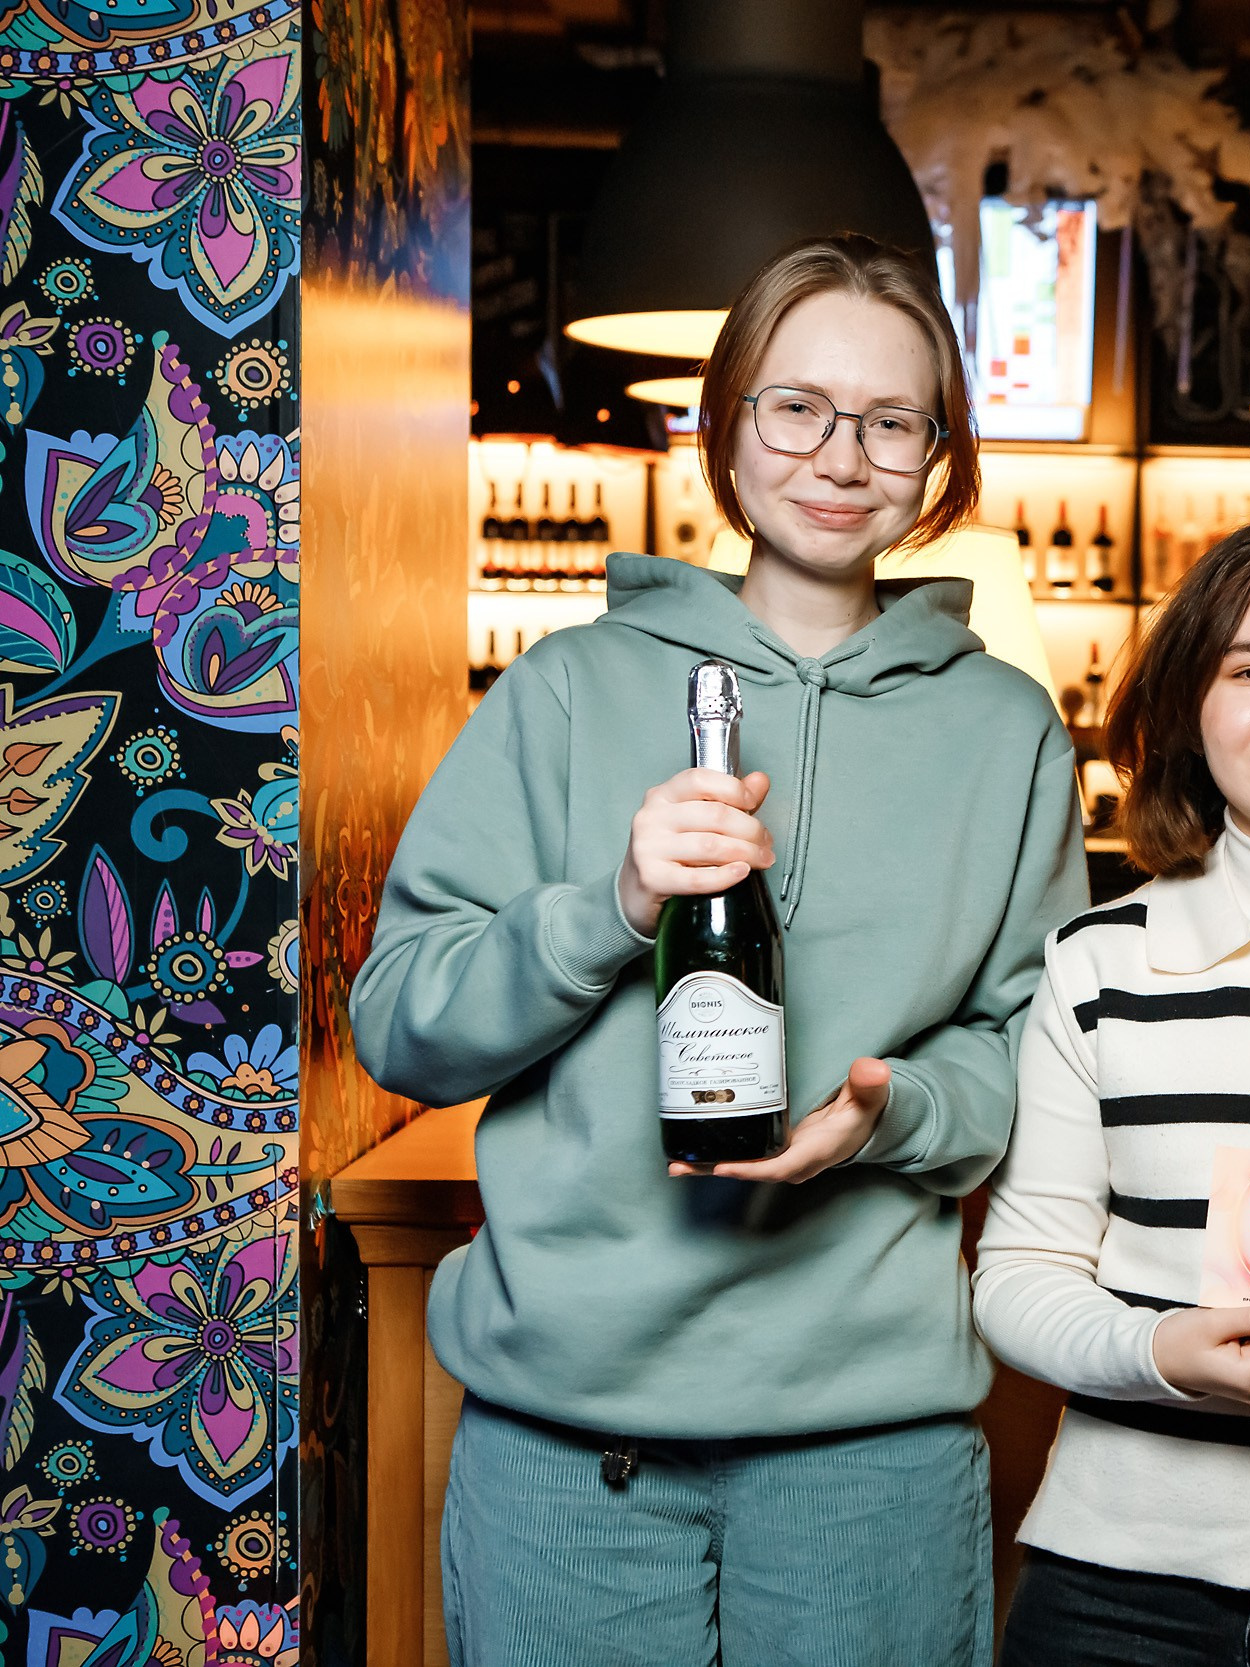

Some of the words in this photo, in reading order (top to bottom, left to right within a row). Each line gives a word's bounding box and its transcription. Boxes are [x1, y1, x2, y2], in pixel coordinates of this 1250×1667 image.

[691, 1000, 722, 1009] DIONIS
[660, 1021, 770, 1039] Шампанское
[677, 1042, 754, 1063] Советское
